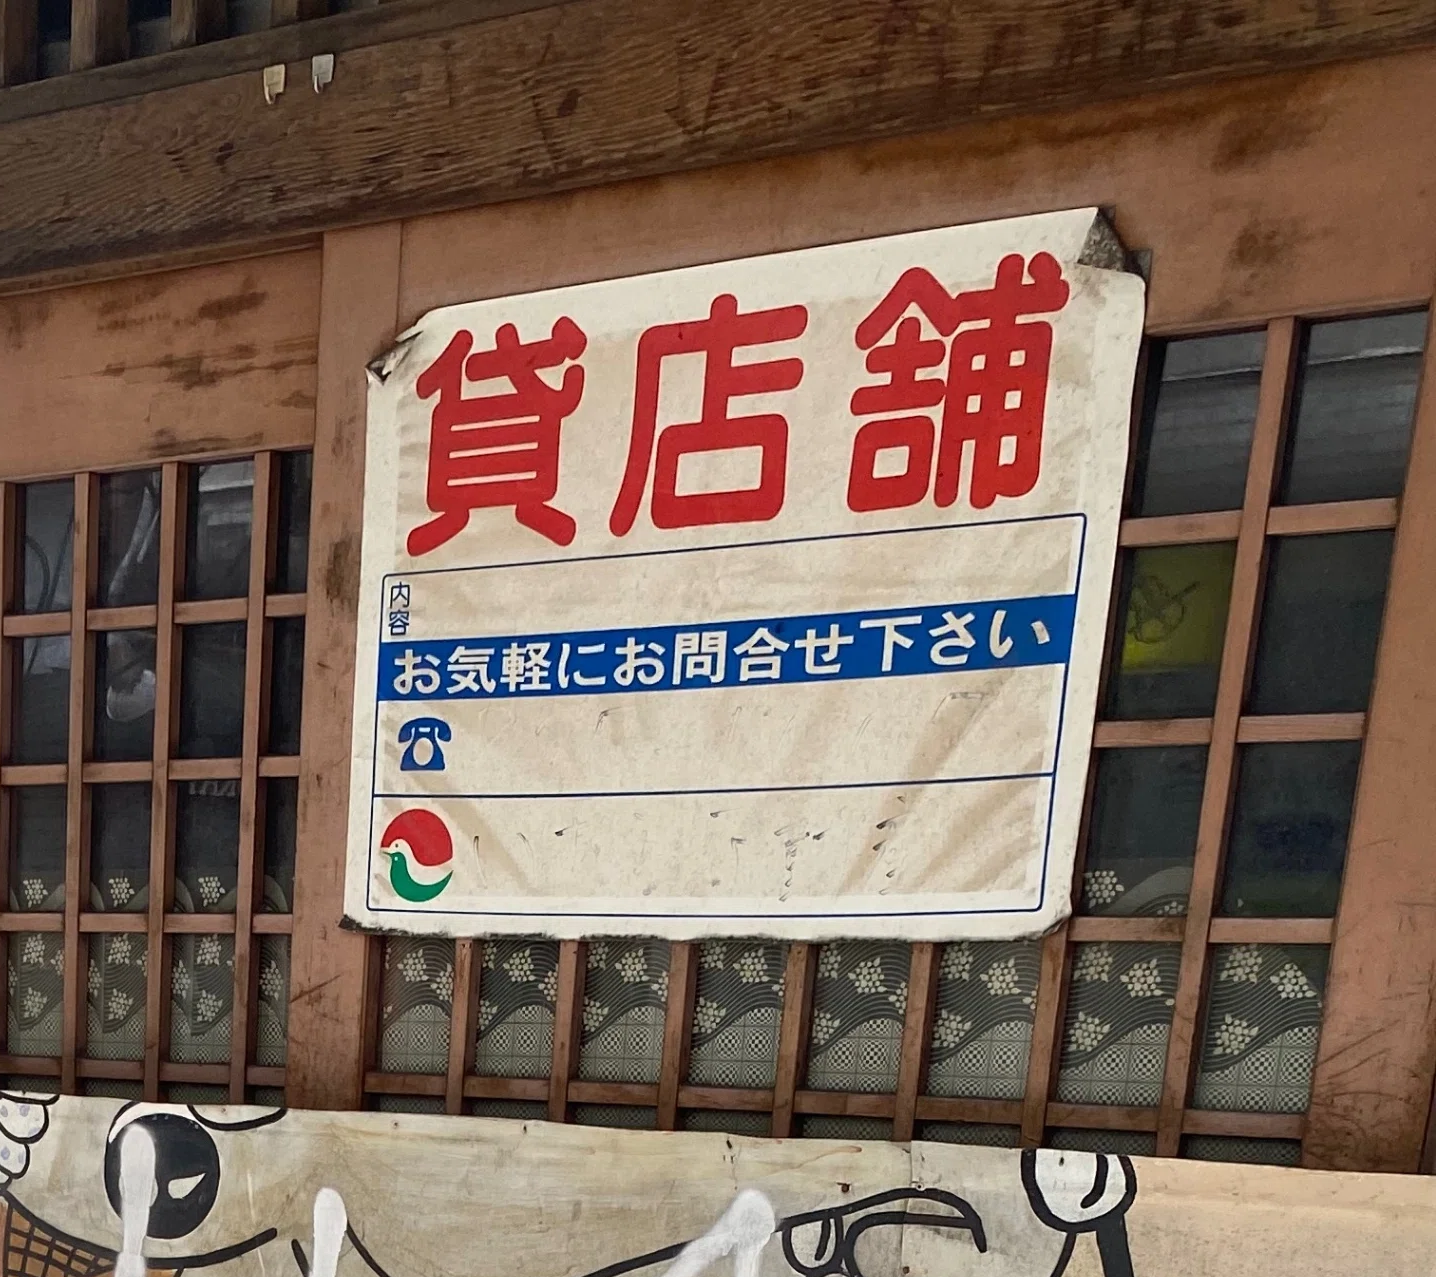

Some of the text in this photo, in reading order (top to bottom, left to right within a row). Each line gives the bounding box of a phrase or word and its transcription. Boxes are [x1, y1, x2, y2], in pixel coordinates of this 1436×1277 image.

[406, 251, 1070, 557] 貸店舗
[388, 581, 411, 637] 内容
[393, 609, 1049, 696] お気軽にお問合せ下さい
